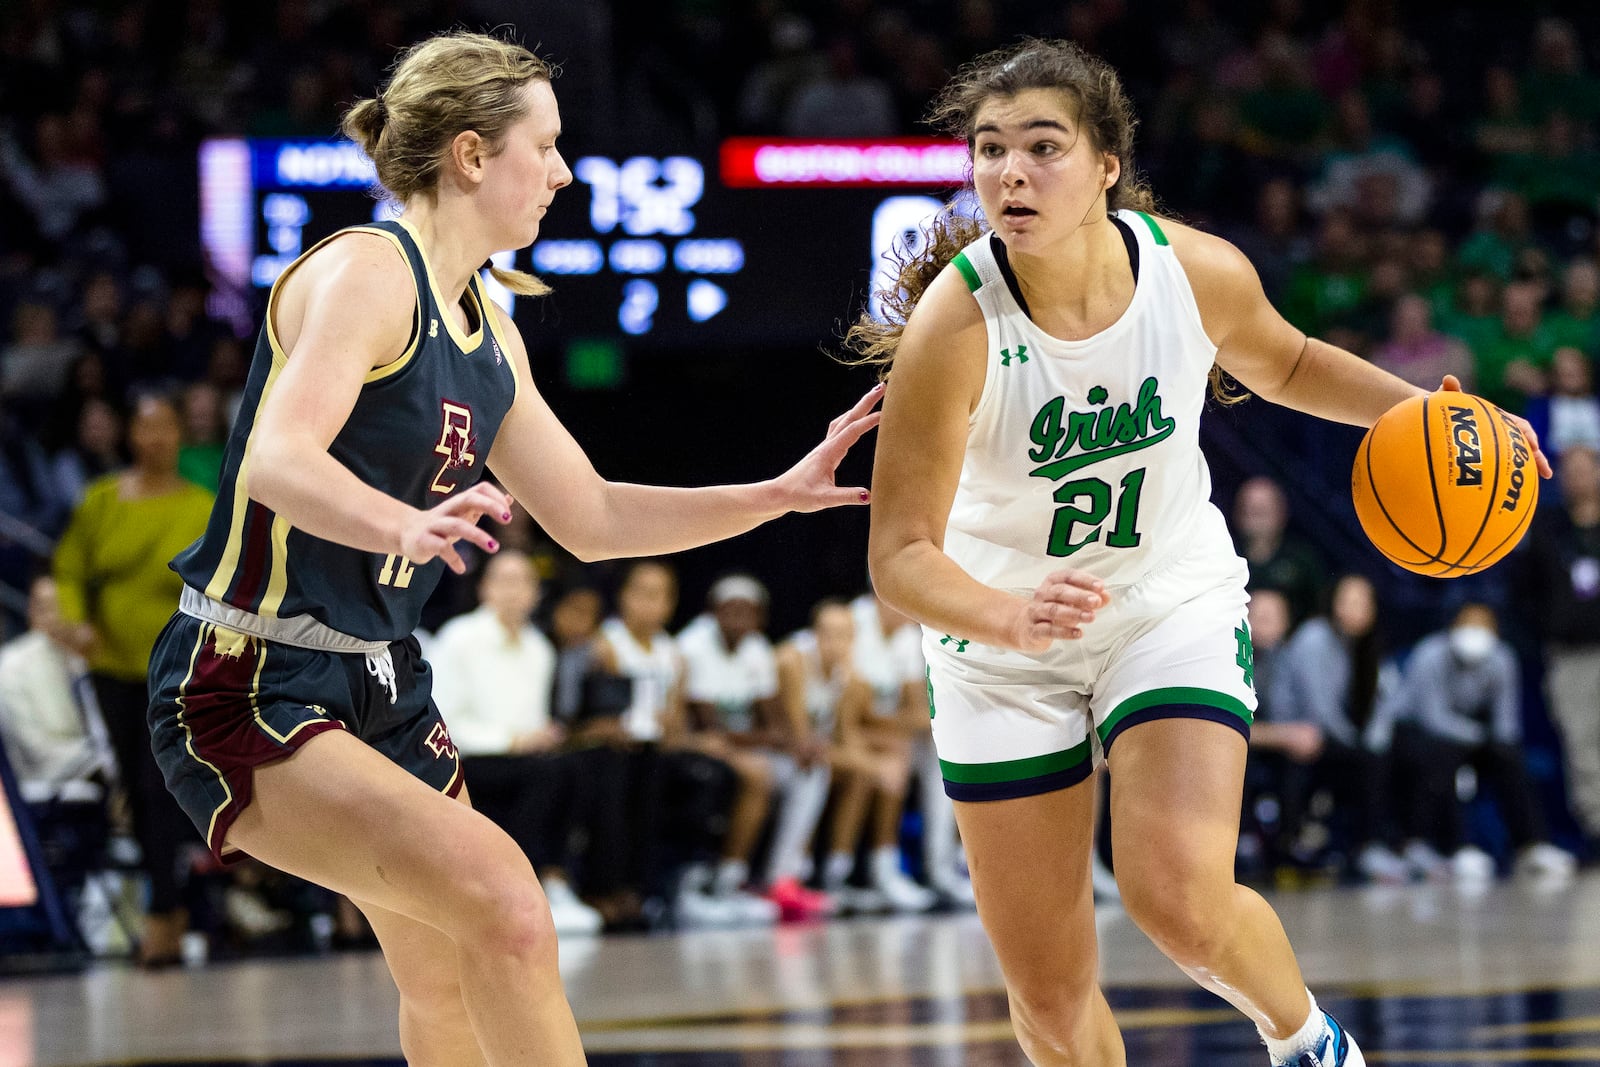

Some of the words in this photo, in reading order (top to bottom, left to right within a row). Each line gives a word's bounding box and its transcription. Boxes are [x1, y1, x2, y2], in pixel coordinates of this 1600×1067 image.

[1028, 377, 1175, 462] Irish
[1448, 405, 1484, 487] NCAA
[1047, 467, 1146, 557] 21
